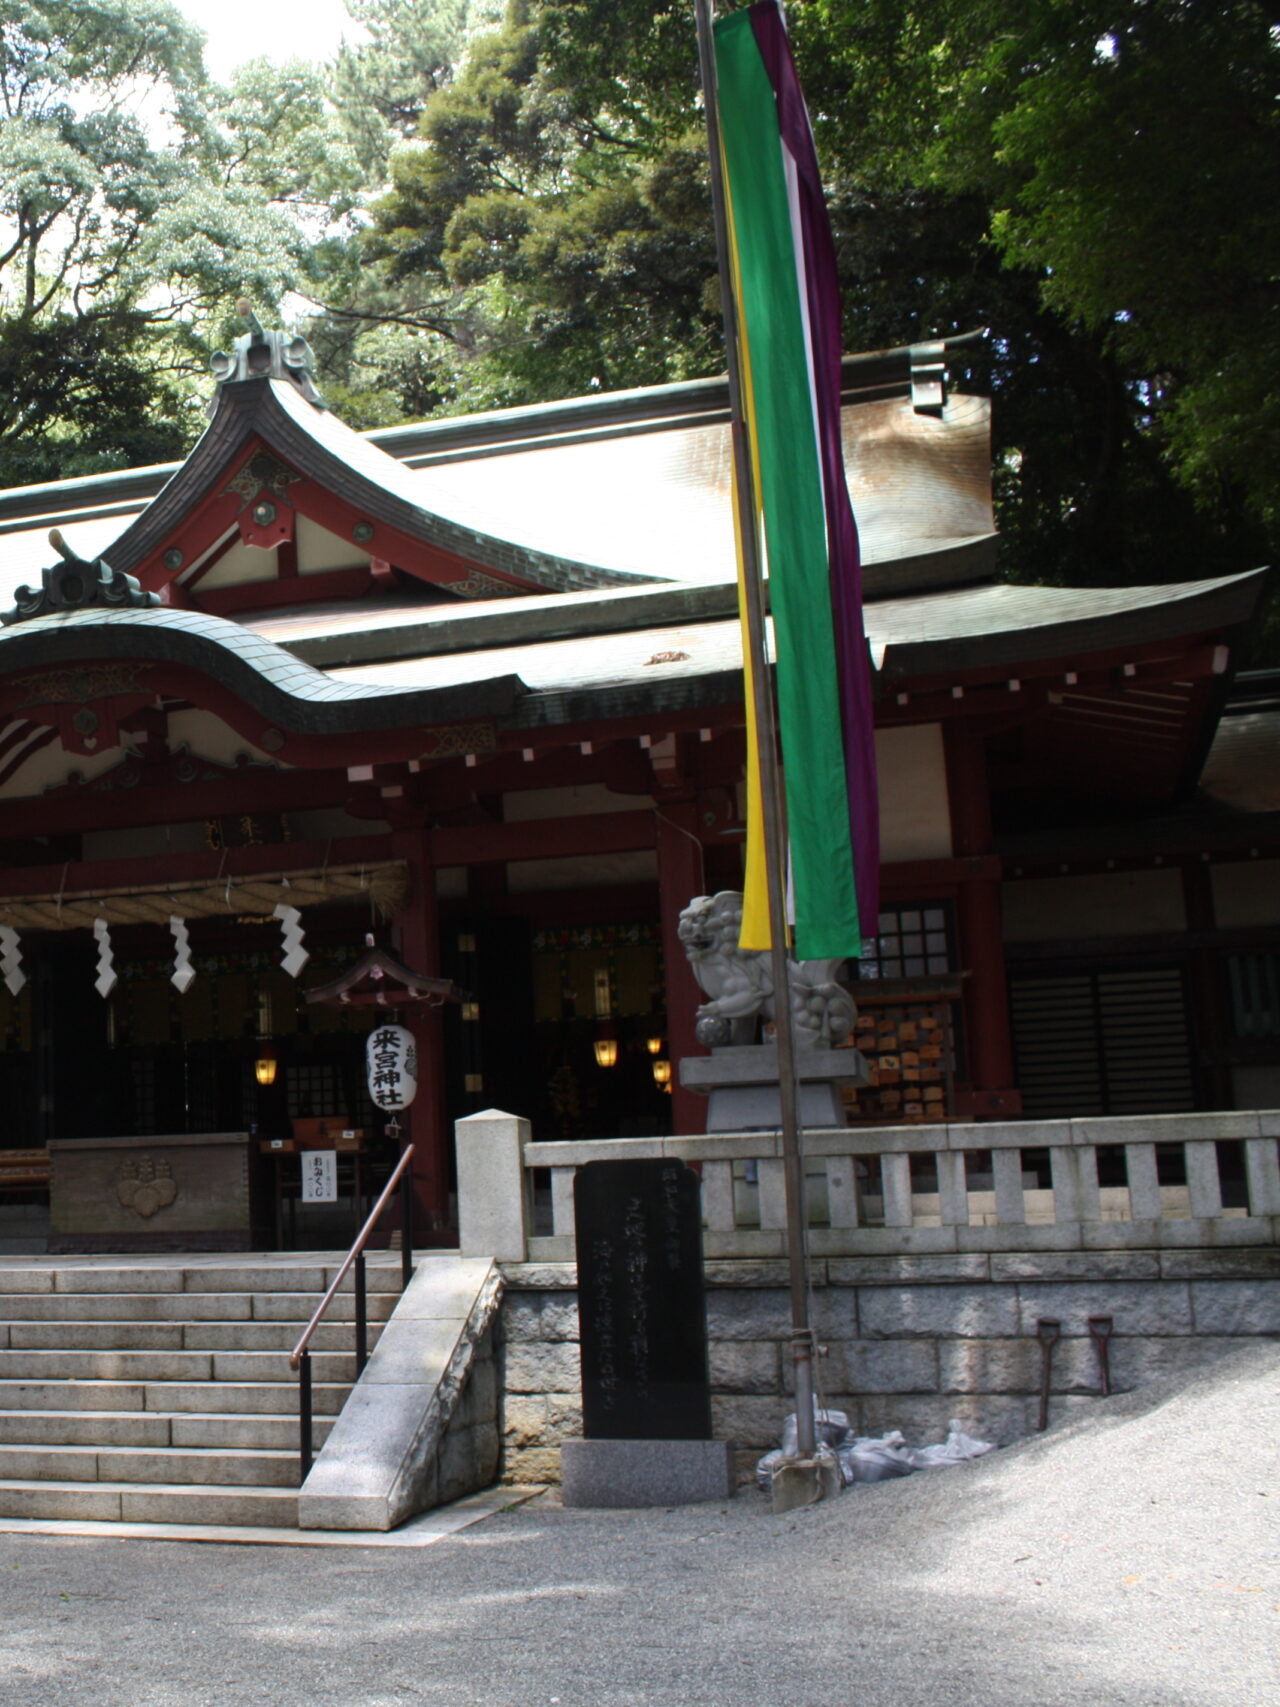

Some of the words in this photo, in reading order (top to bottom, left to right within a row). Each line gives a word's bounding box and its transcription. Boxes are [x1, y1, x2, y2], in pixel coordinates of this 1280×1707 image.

[373, 1030, 403, 1105] 来宮神社
[313, 1157, 324, 1197] おみくじ
